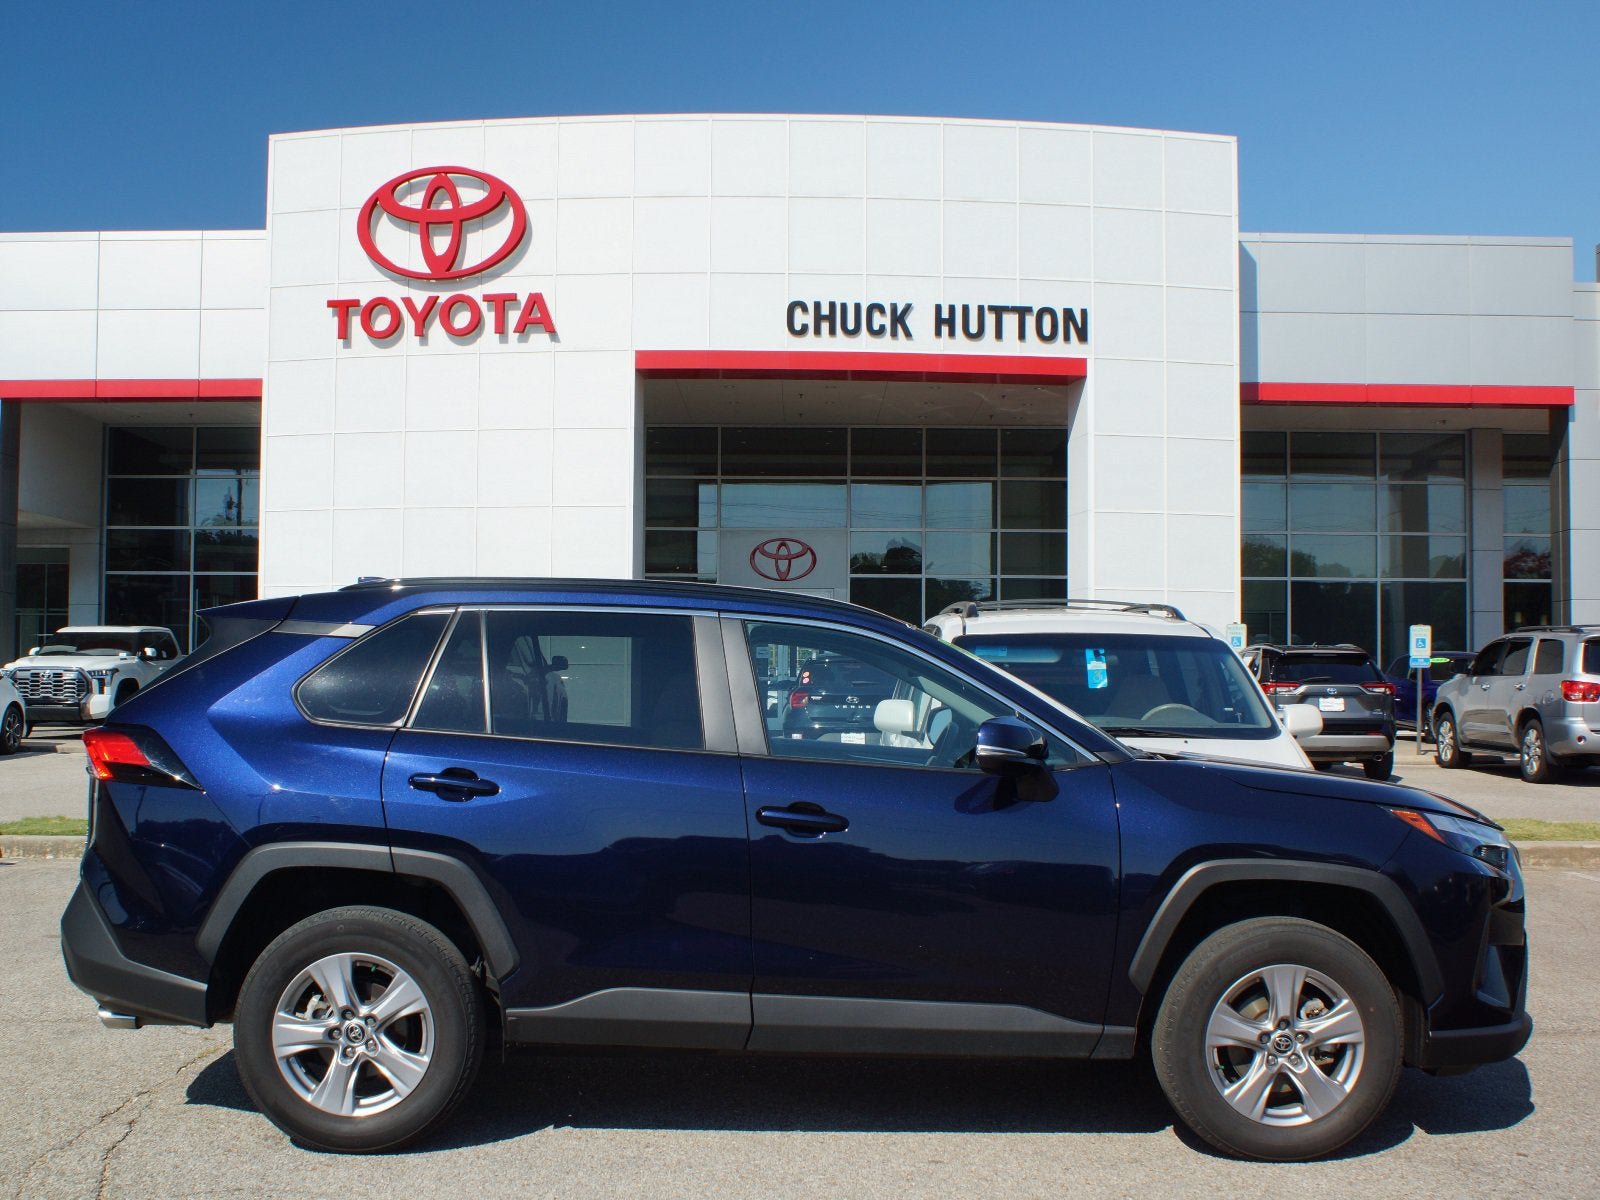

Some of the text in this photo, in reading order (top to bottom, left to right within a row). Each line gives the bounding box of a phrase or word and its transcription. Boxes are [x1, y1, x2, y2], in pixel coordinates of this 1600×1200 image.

[327, 292, 556, 340] TOYOTA
[786, 300, 1088, 343] CHUCK HUTTON
